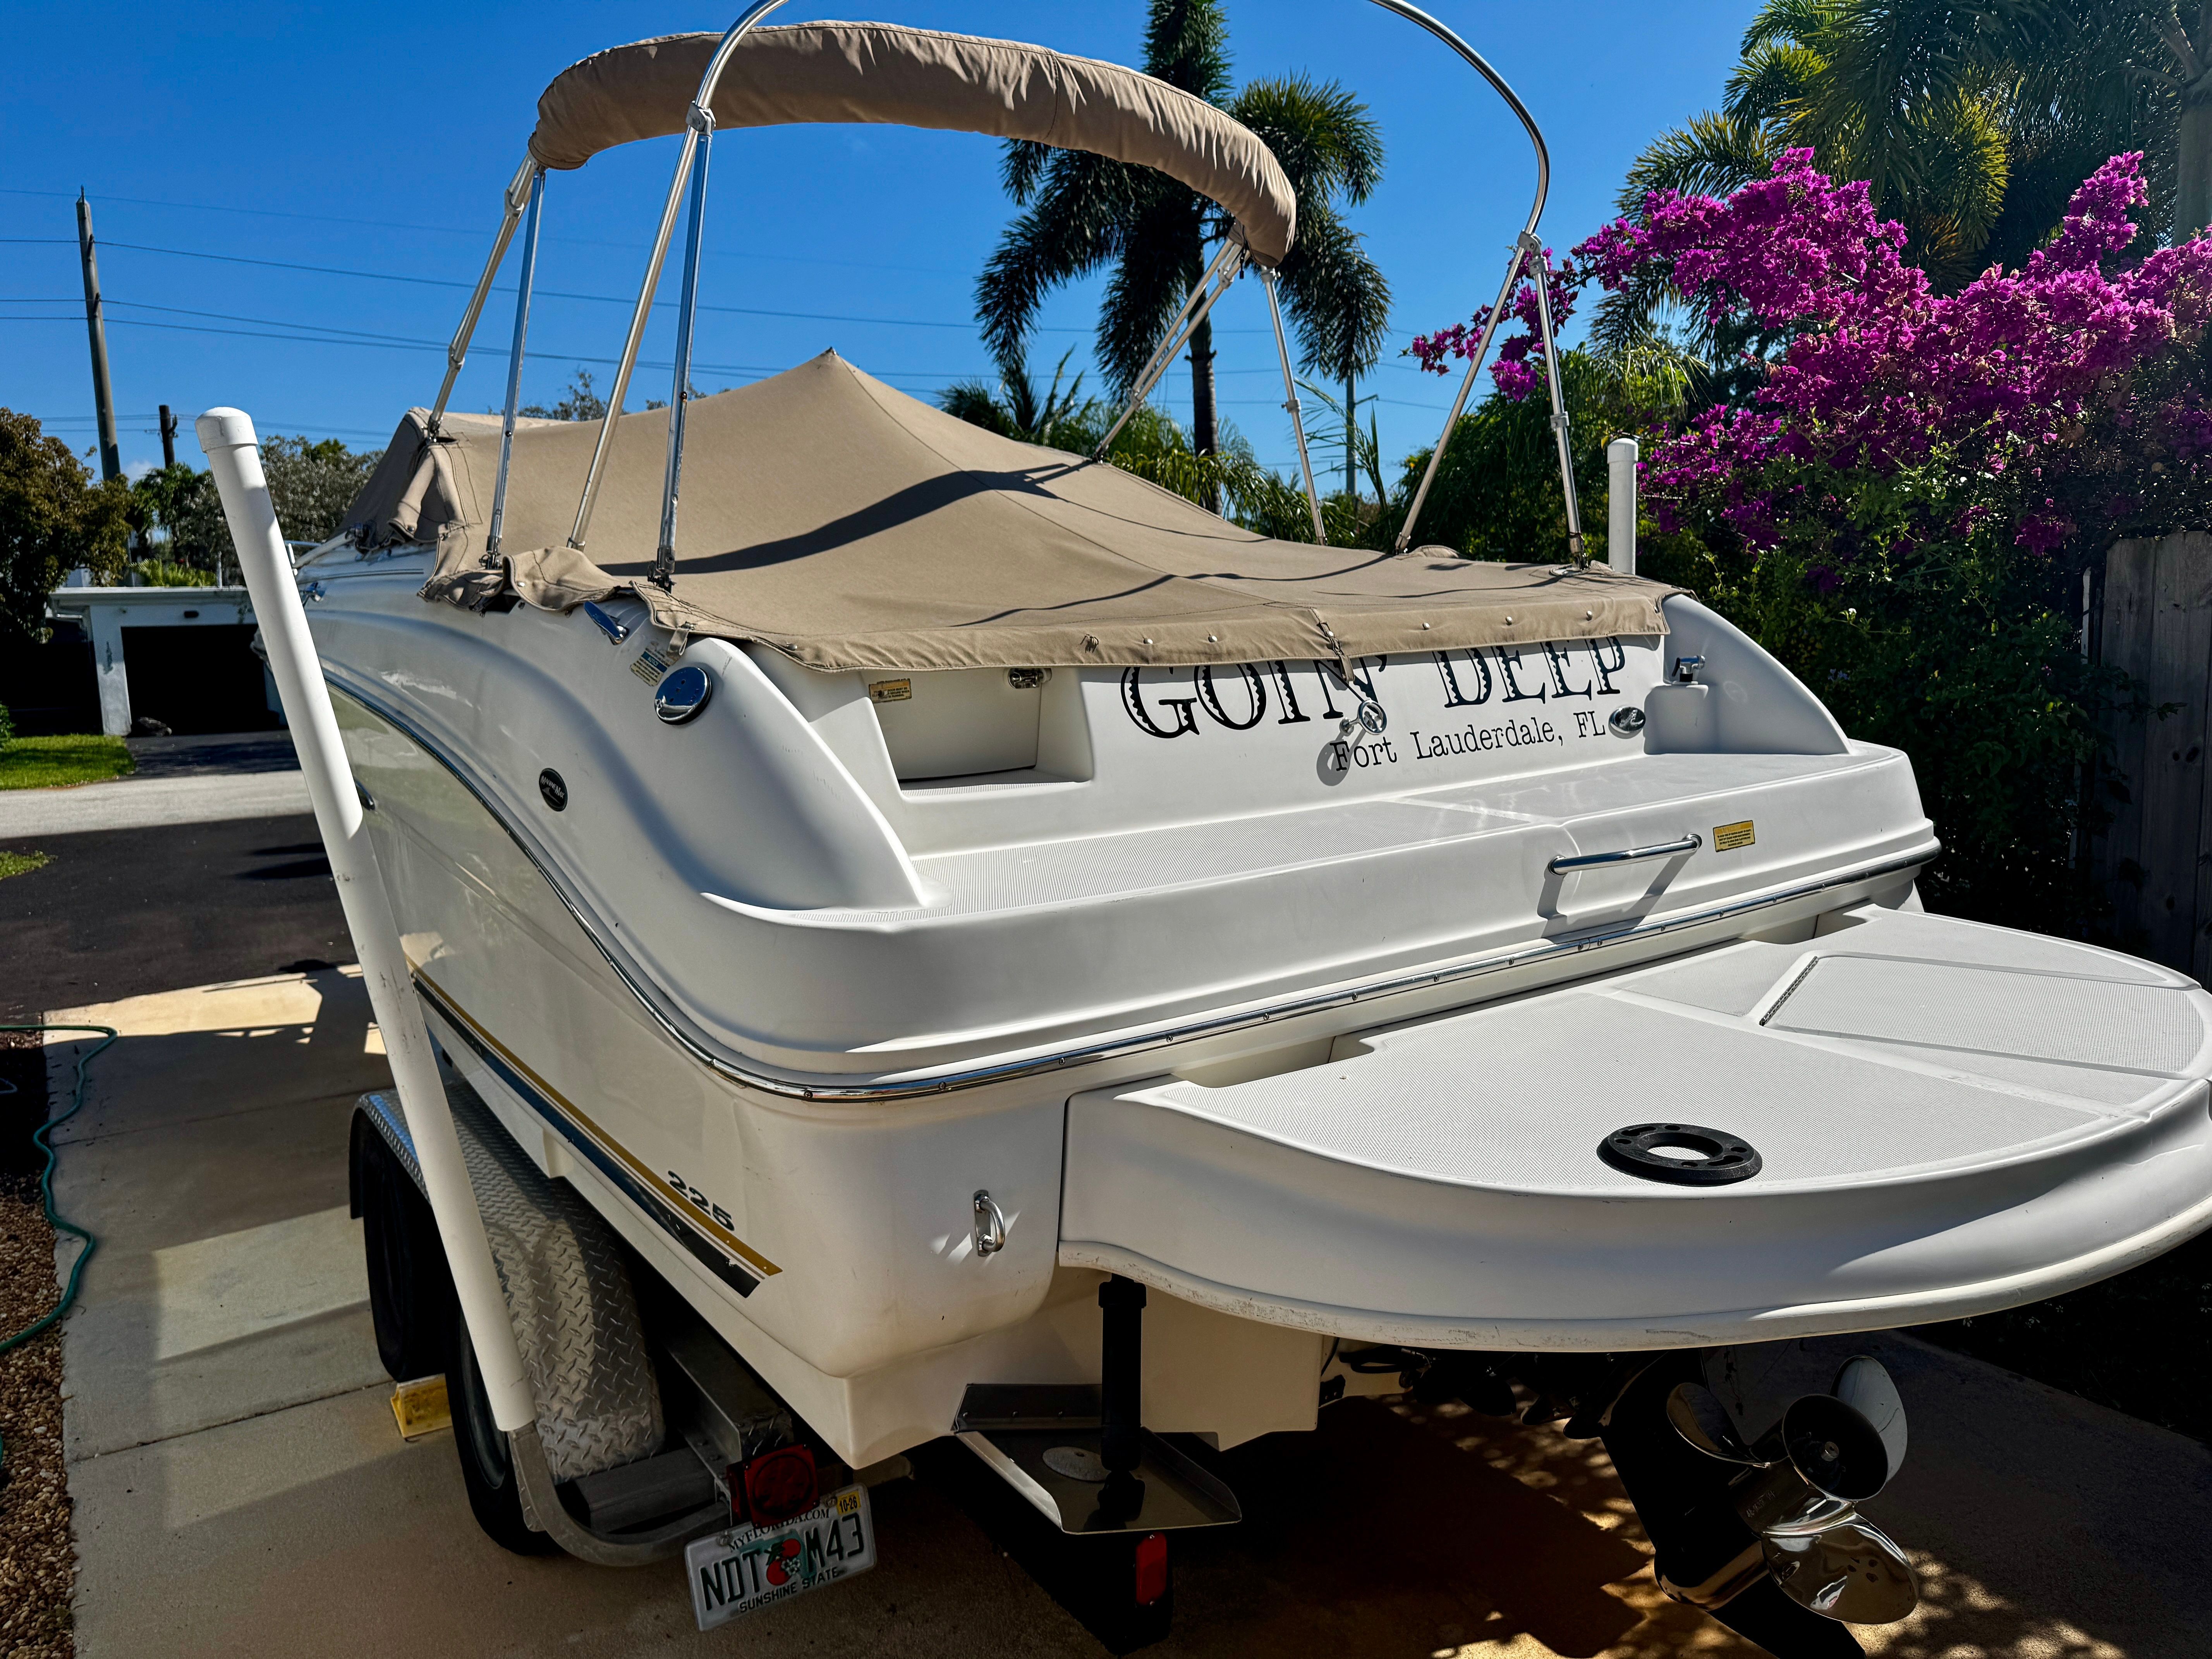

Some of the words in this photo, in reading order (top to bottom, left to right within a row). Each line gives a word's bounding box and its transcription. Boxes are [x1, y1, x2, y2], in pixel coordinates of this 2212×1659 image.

[1329, 736, 1398, 771] Fort
[1416, 716, 1564, 761] Lauderdale,
[1577, 710, 1606, 738] FL
[668, 1170, 735, 1231] 225
[840, 1496, 858, 1512] 10-26
[700, 1550, 761, 1611] NDT
[805, 1513, 864, 1573] M43
[740, 1582, 797, 1613] SUNSHINE
[802, 1567, 840, 1589] STATE
